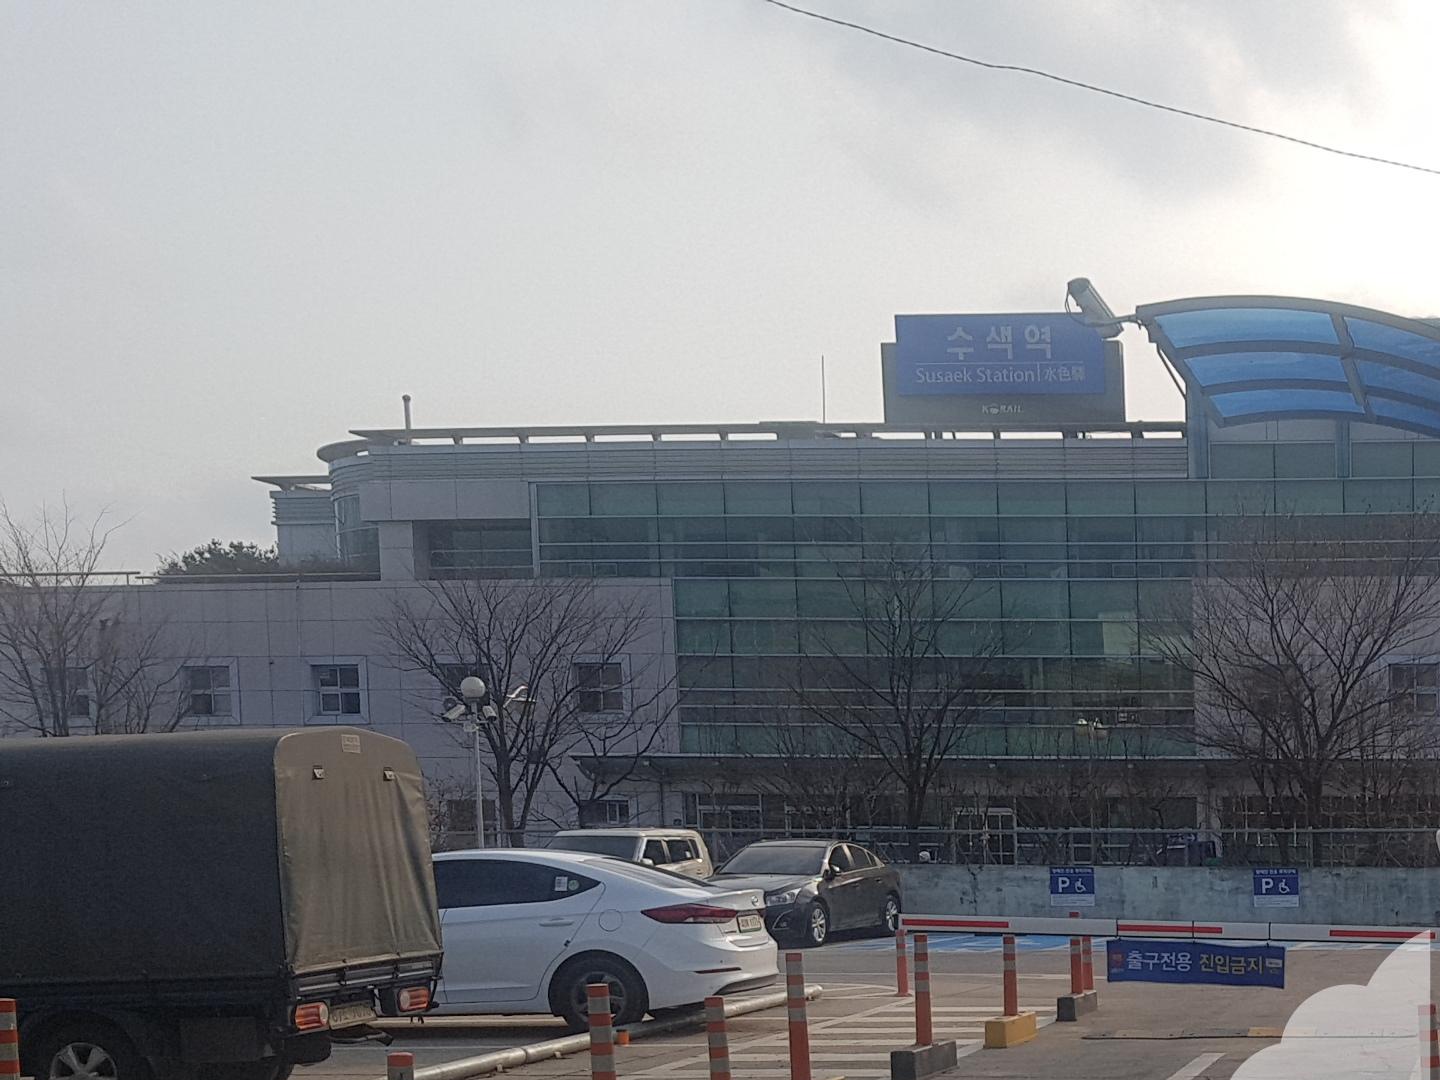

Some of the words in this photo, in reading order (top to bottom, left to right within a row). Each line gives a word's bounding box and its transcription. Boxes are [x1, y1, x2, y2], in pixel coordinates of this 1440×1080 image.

[947, 325, 1052, 361] 수색역
[916, 367, 972, 384] Susaek
[976, 367, 1037, 384] Station
[1058, 876, 1070, 893] P
[1261, 877, 1274, 894] P
[1126, 951, 1193, 973] 출구전용
[1199, 953, 1264, 976] 진입금지
